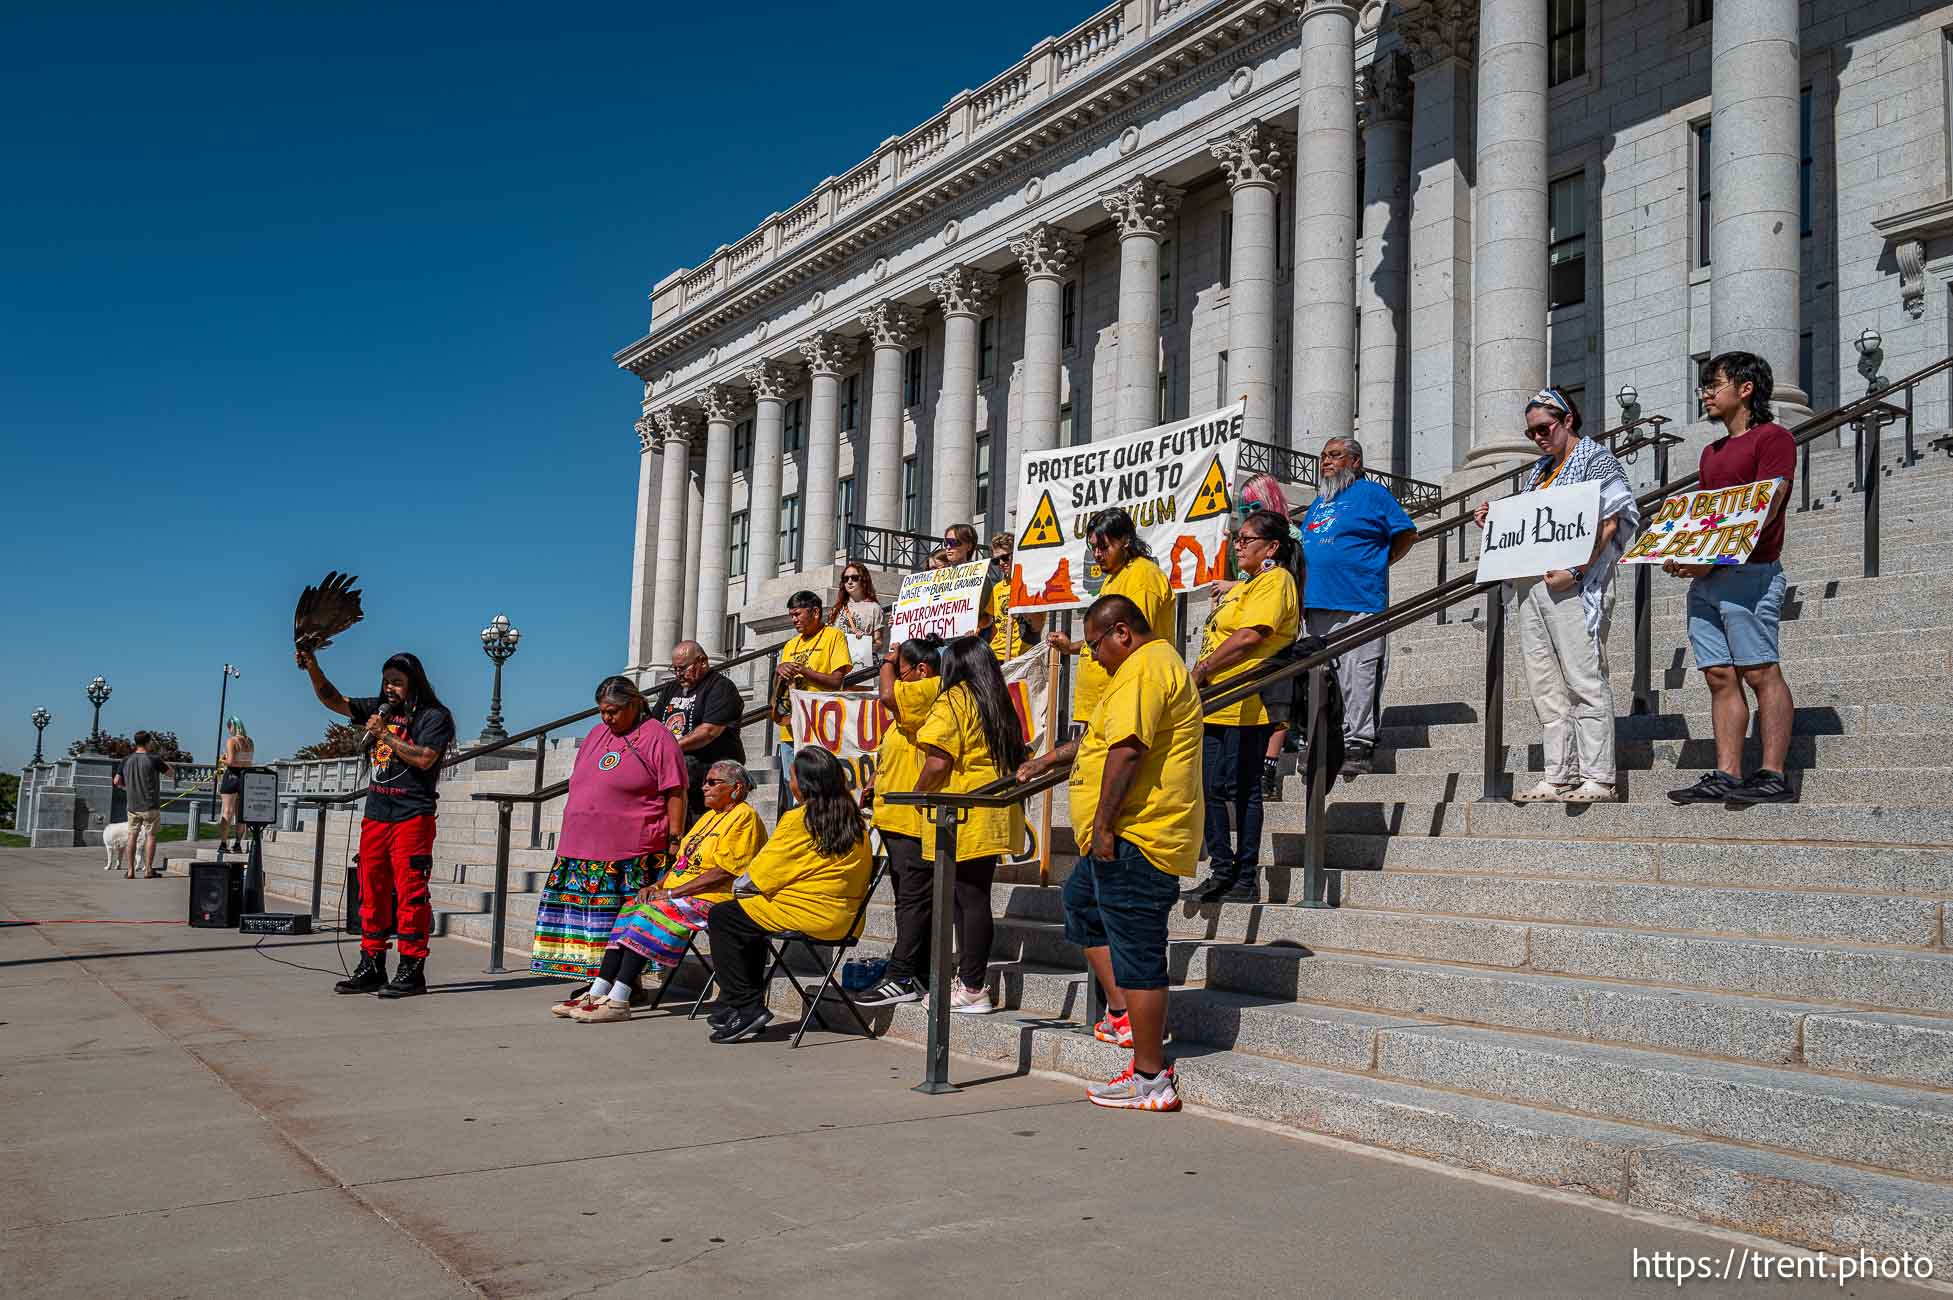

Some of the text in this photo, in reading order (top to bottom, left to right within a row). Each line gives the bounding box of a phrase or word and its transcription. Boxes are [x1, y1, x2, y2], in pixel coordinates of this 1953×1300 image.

[1027, 414, 1243, 484] PROTECT OUR FUTURE
[1071, 462, 1183, 508] SAY NO TO
[1653, 481, 1774, 524] DO BETTER
[1073, 495, 1176, 540] UIUM
[1484, 506, 1591, 554] Land Back.
[1627, 520, 1759, 558] BE BETTER
[901, 585, 922, 600] WASTE
[930, 581, 953, 595] BURIAL
[954, 576, 984, 591] GROUNDS
[895, 599, 974, 626] ENVIRONMENTAL
[799, 697, 846, 753] NO
